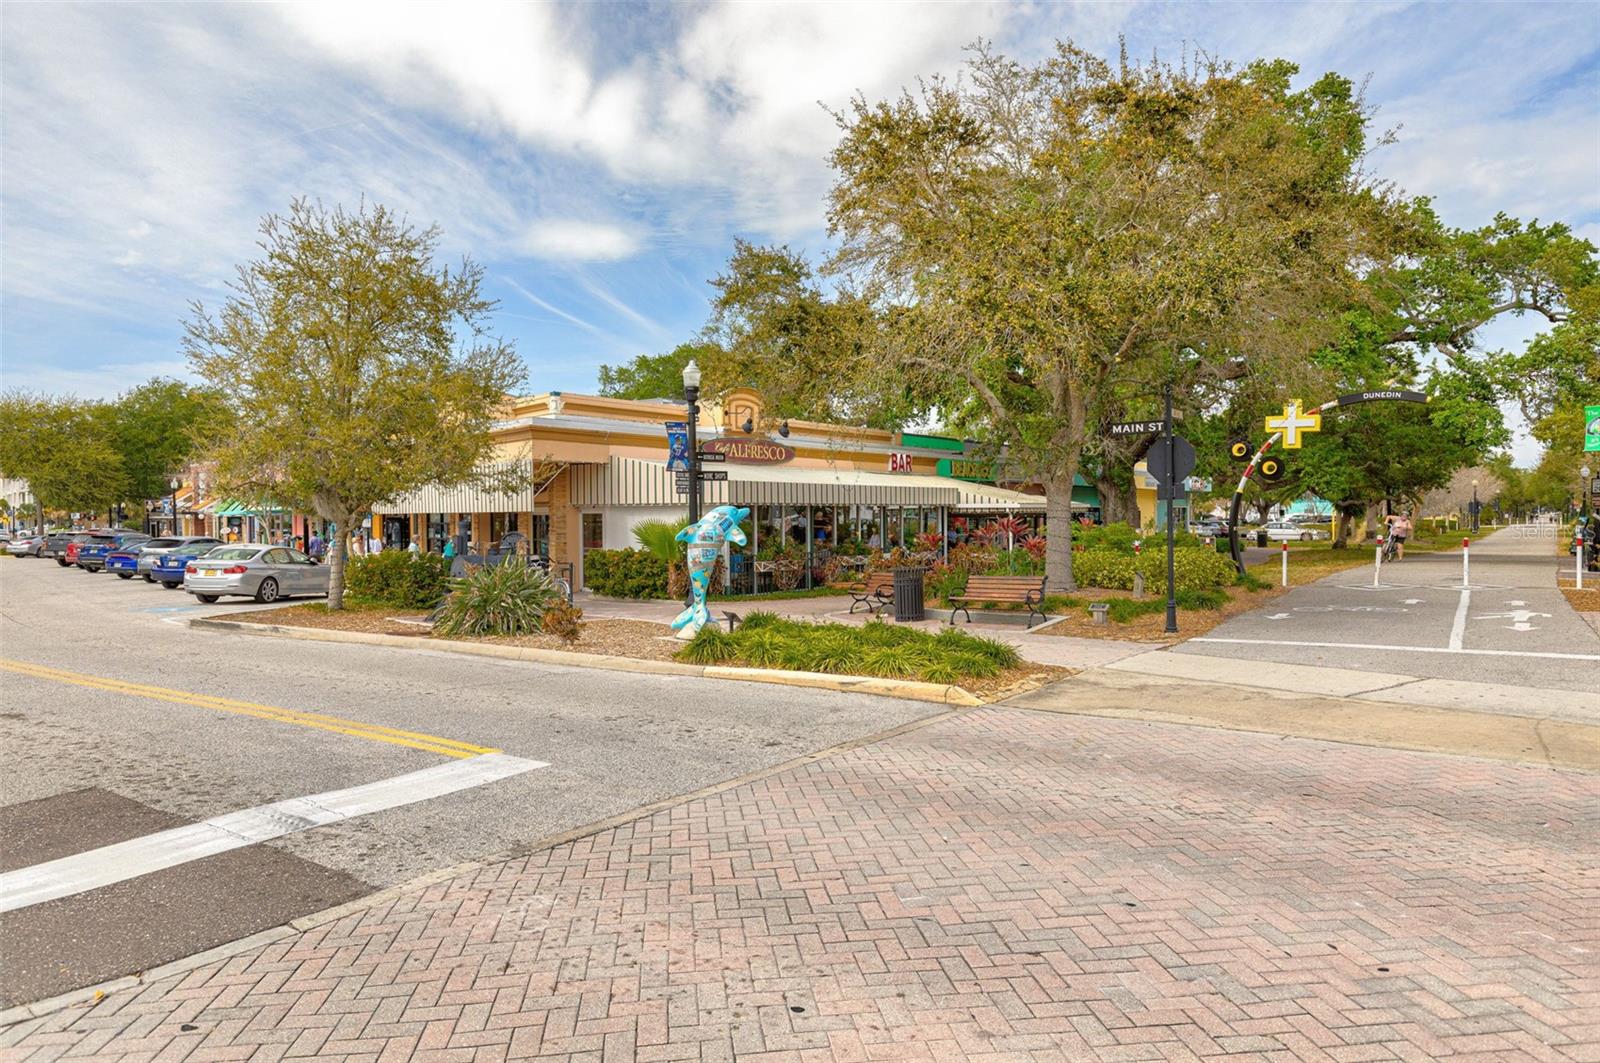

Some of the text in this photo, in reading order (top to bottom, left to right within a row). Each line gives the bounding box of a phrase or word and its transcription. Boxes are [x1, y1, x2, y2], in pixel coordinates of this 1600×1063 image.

[1112, 422, 1163, 433] MAIN ST
[729, 443, 785, 460] ALFRESCO
[891, 453, 913, 473] BAR
